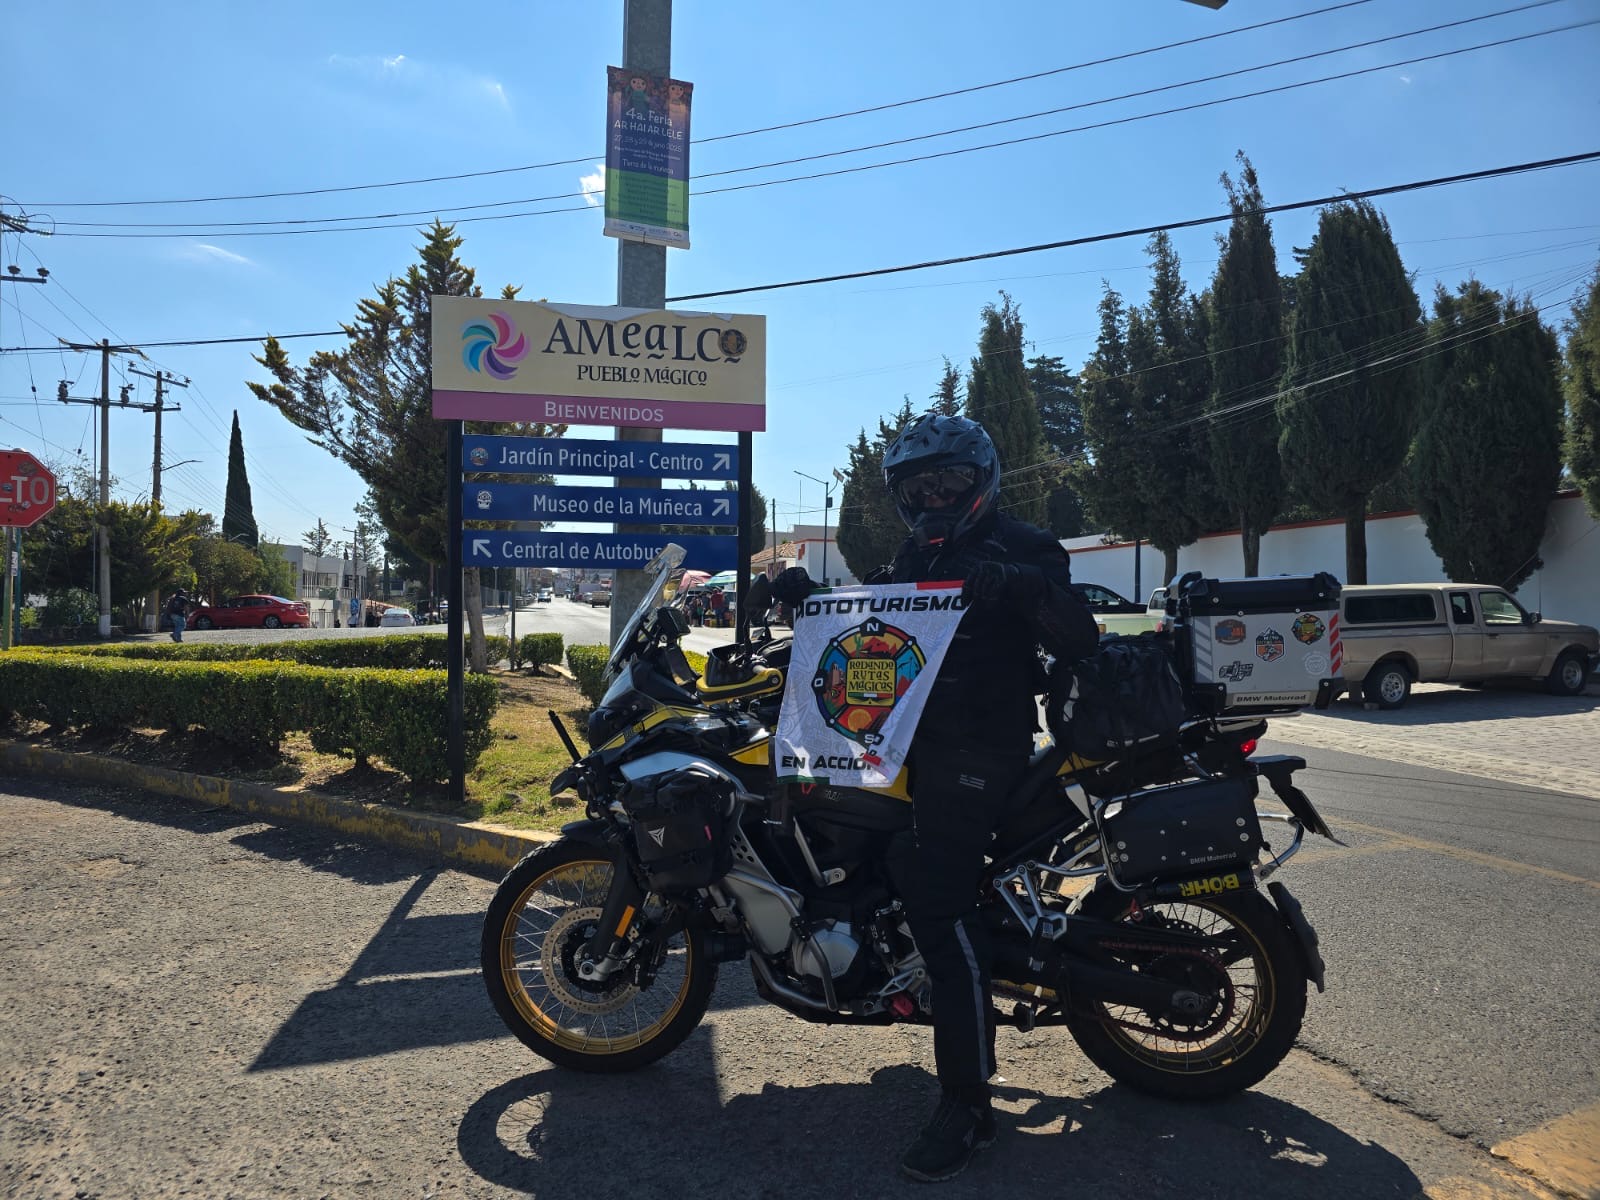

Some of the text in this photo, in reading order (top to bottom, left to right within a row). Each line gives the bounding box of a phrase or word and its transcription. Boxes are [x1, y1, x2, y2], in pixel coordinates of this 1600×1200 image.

[648, 110, 673, 127] Feria
[614, 119, 628, 130] AR
[647, 125, 660, 136] AR
[544, 401, 664, 422] BIENVENIDOS
[499, 446, 553, 467] Jardín
[559, 449, 635, 472] Principal
[649, 452, 703, 471] Centro
[533, 494, 703, 517] Museo de la Muñeca
[502, 540, 566, 560] Central
[569, 541, 590, 560] de
[866, 622, 879, 632] N
[1236, 695, 1261, 703] BMW
[781, 755, 806, 769] EN
